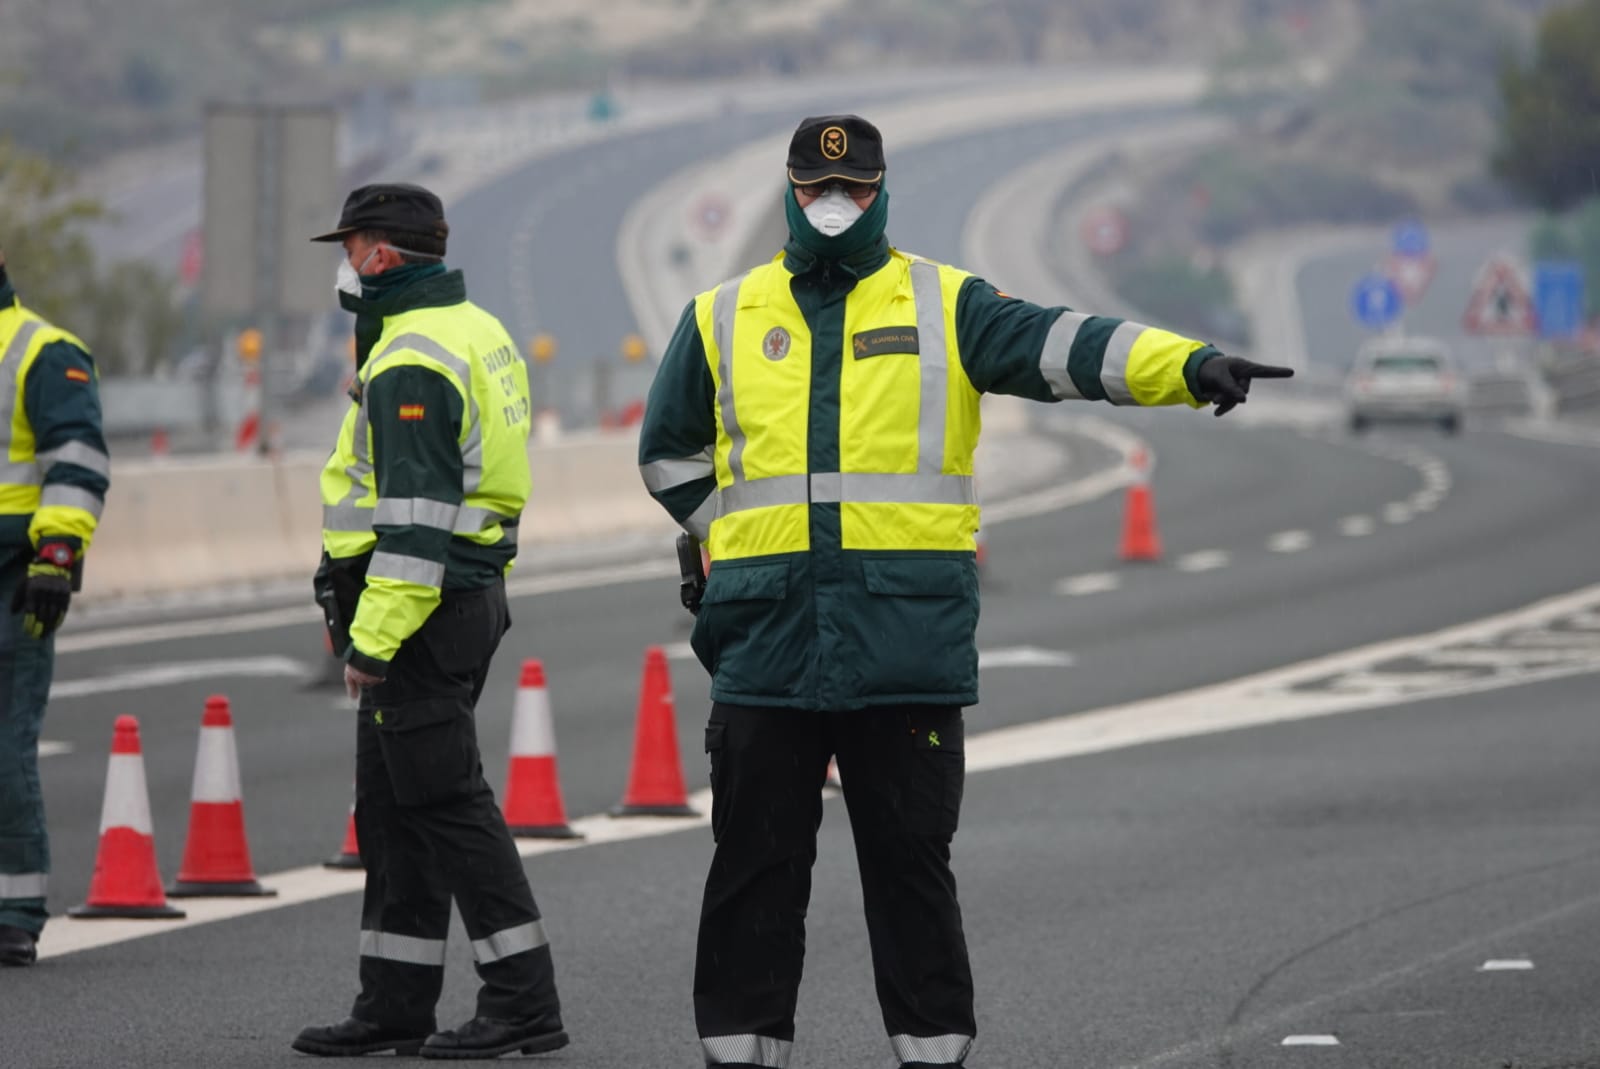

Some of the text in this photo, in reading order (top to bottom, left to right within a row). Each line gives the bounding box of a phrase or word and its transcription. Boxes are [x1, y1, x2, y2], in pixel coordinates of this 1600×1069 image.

[872, 335, 916, 344] GUARDIA CIVIL
[482, 345, 517, 374] GUARD
